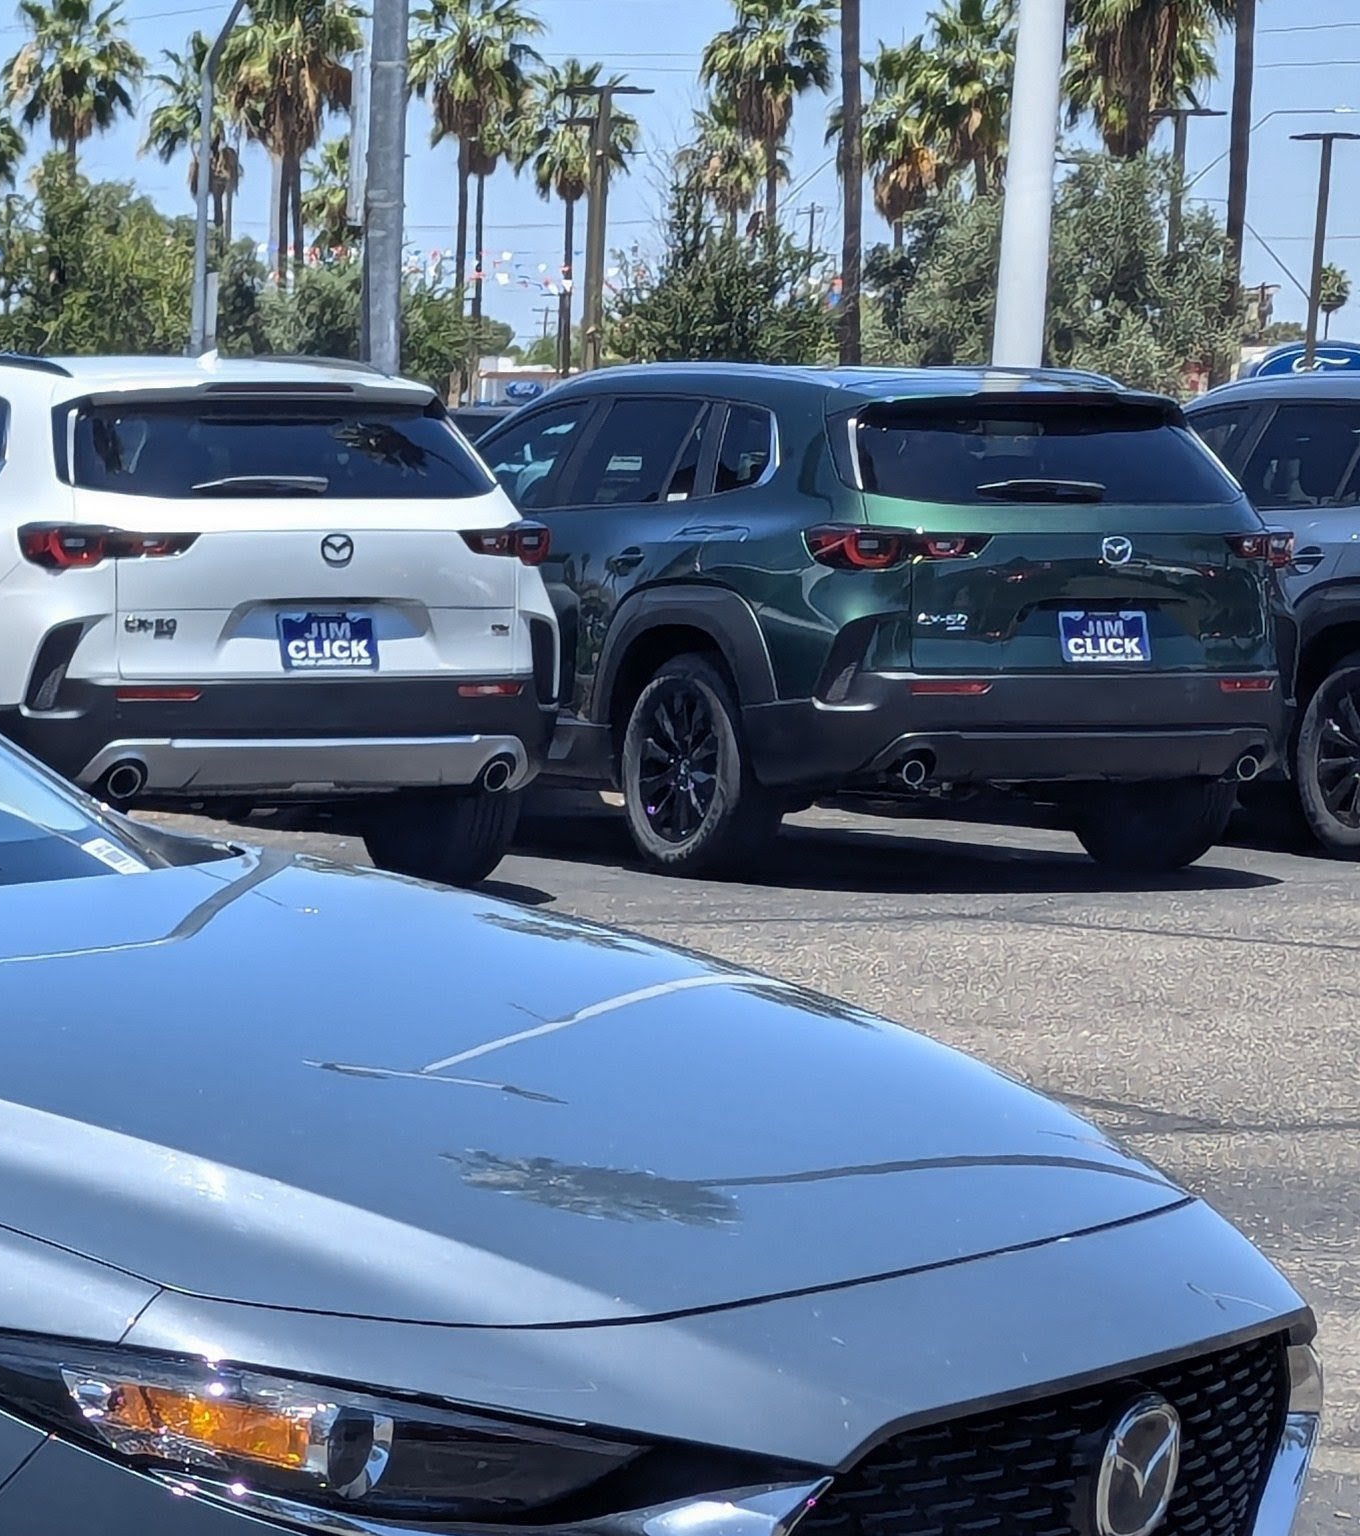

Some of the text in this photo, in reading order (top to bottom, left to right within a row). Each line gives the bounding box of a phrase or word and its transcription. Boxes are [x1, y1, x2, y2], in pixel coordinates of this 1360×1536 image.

[304, 622, 351, 639] JIM
[1083, 620, 1124, 637] JIM
[287, 639, 369, 658] CLICK
[1067, 637, 1141, 654] CLICK
